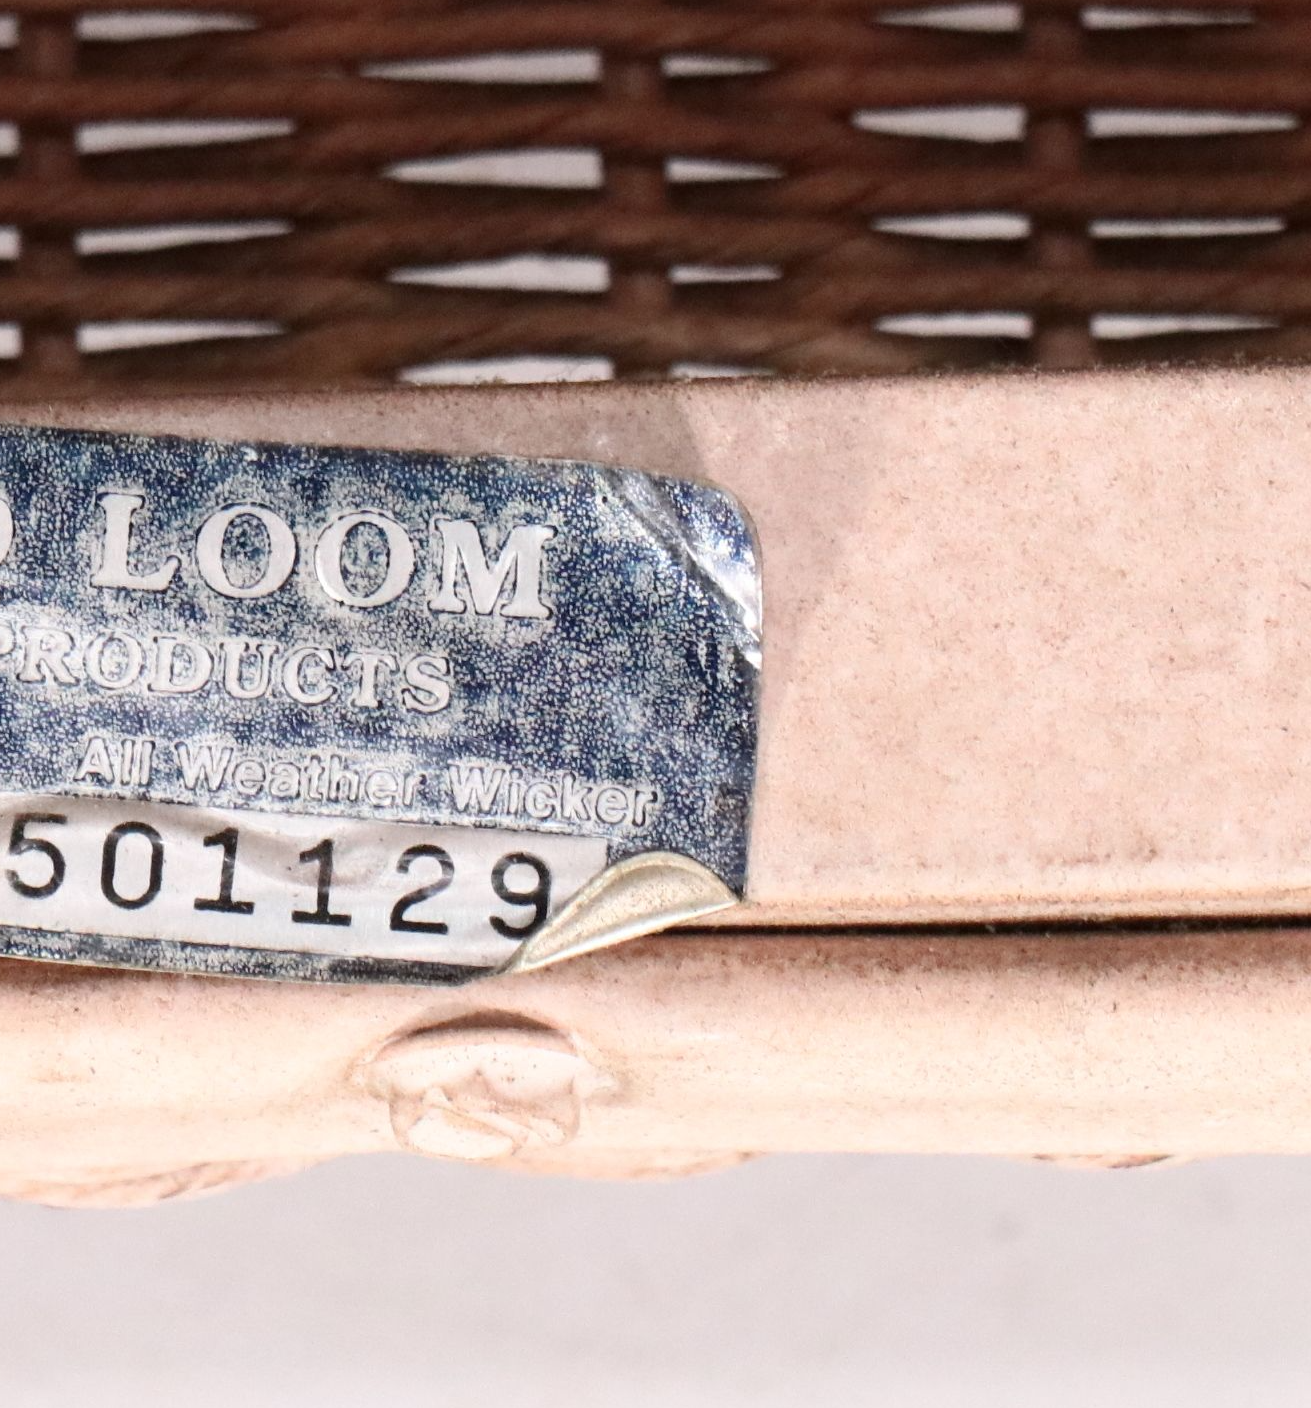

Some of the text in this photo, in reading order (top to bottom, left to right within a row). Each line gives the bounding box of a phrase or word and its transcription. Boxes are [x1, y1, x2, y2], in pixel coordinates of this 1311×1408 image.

[89, 489, 558, 622] LOOM
[75, 734, 660, 827] All Weather Wicker
[4, 811, 554, 940] 501129
